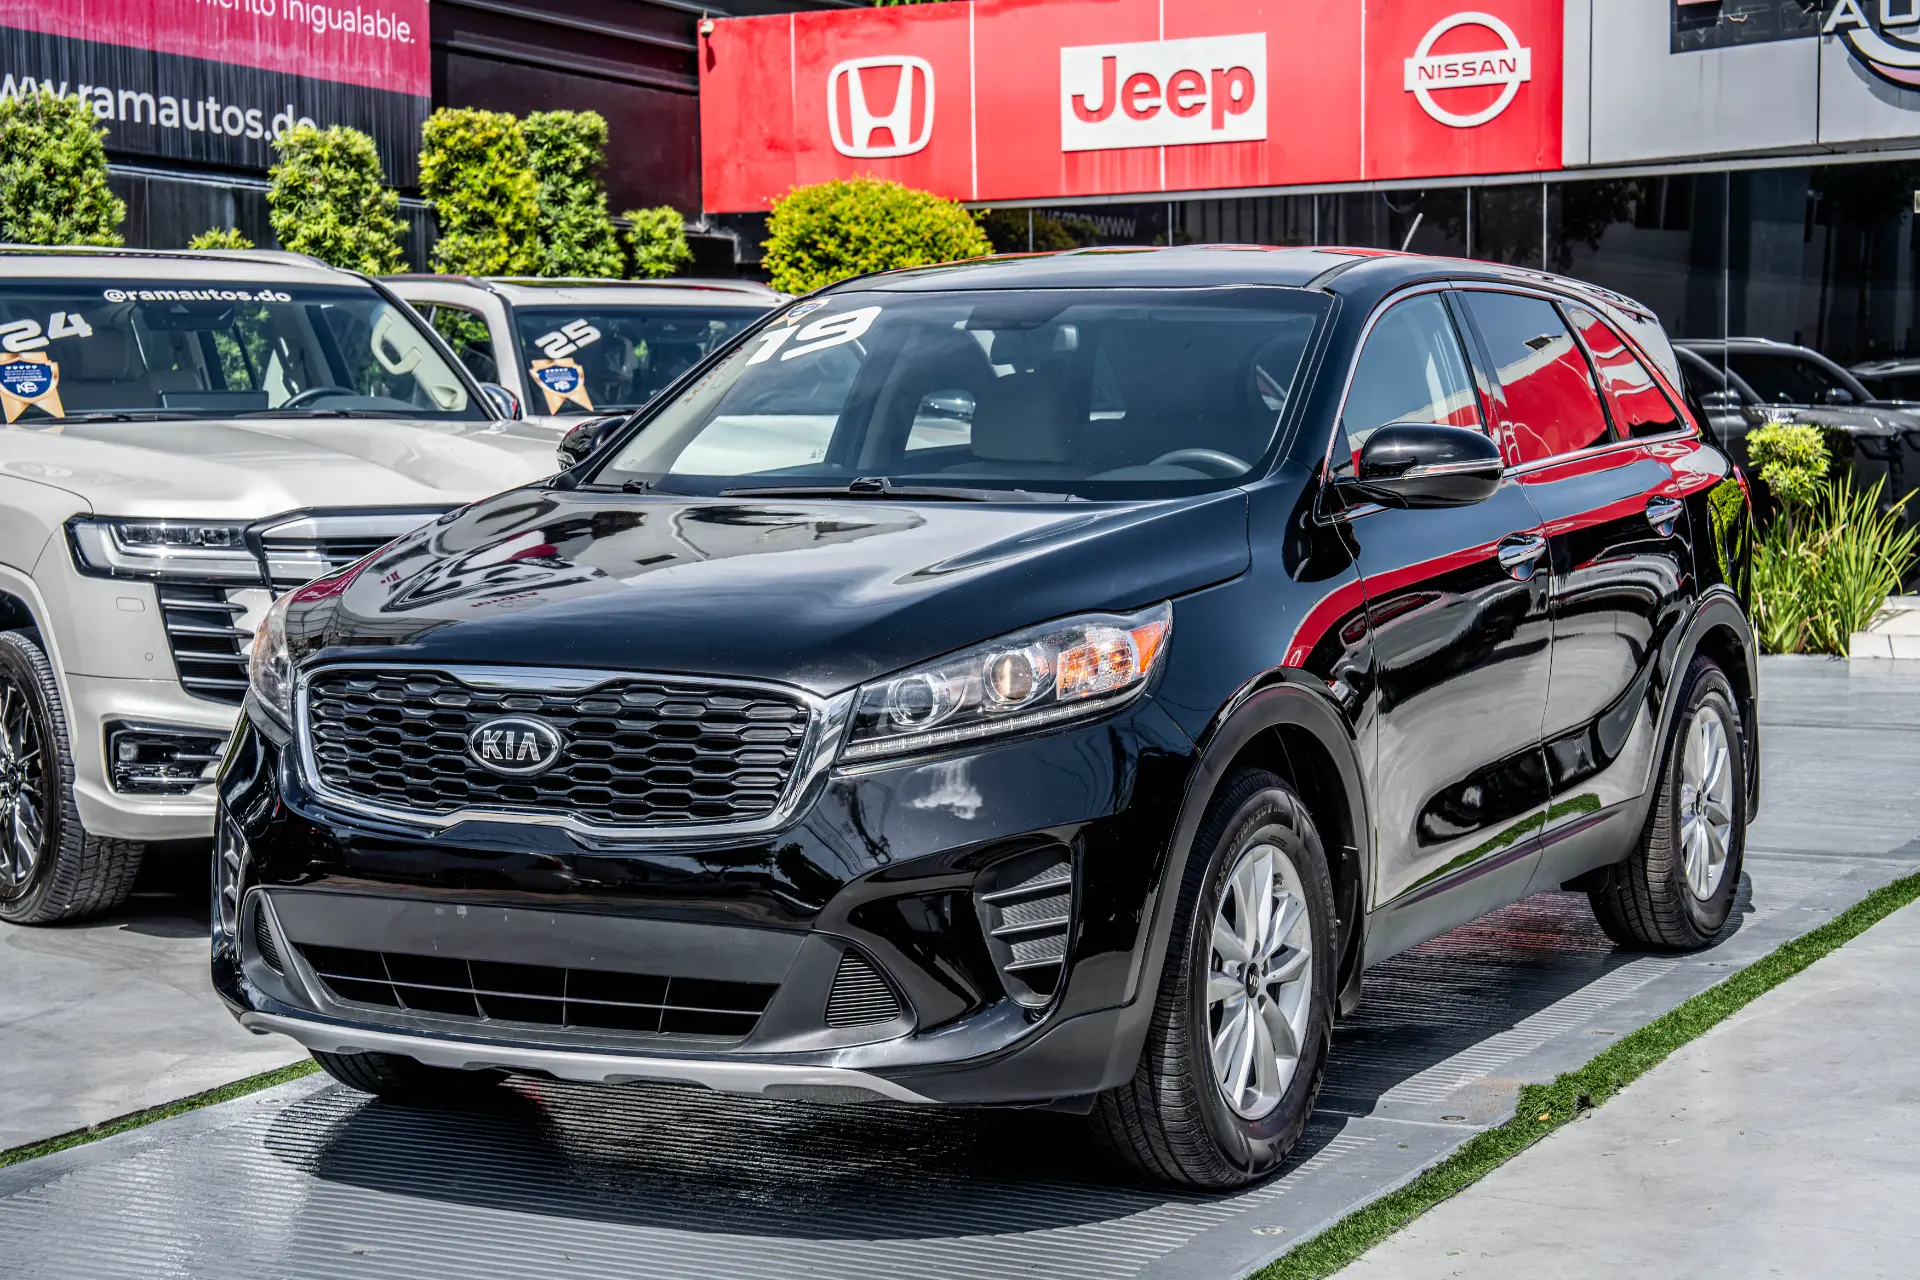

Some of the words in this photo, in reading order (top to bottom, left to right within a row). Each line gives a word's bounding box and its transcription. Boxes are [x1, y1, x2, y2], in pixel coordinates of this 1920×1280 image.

[283, 0, 415, 43] Inigualable.
[1417, 57, 1517, 81] NISSAN
[1071, 56, 1256, 130] Jeep
[103, 288, 292, 302] @ramautos.do
[0, 311, 93, 353] 24
[534, 318, 601, 359] 25
[745, 306, 883, 365] 19
[482, 729, 541, 761] KIA
